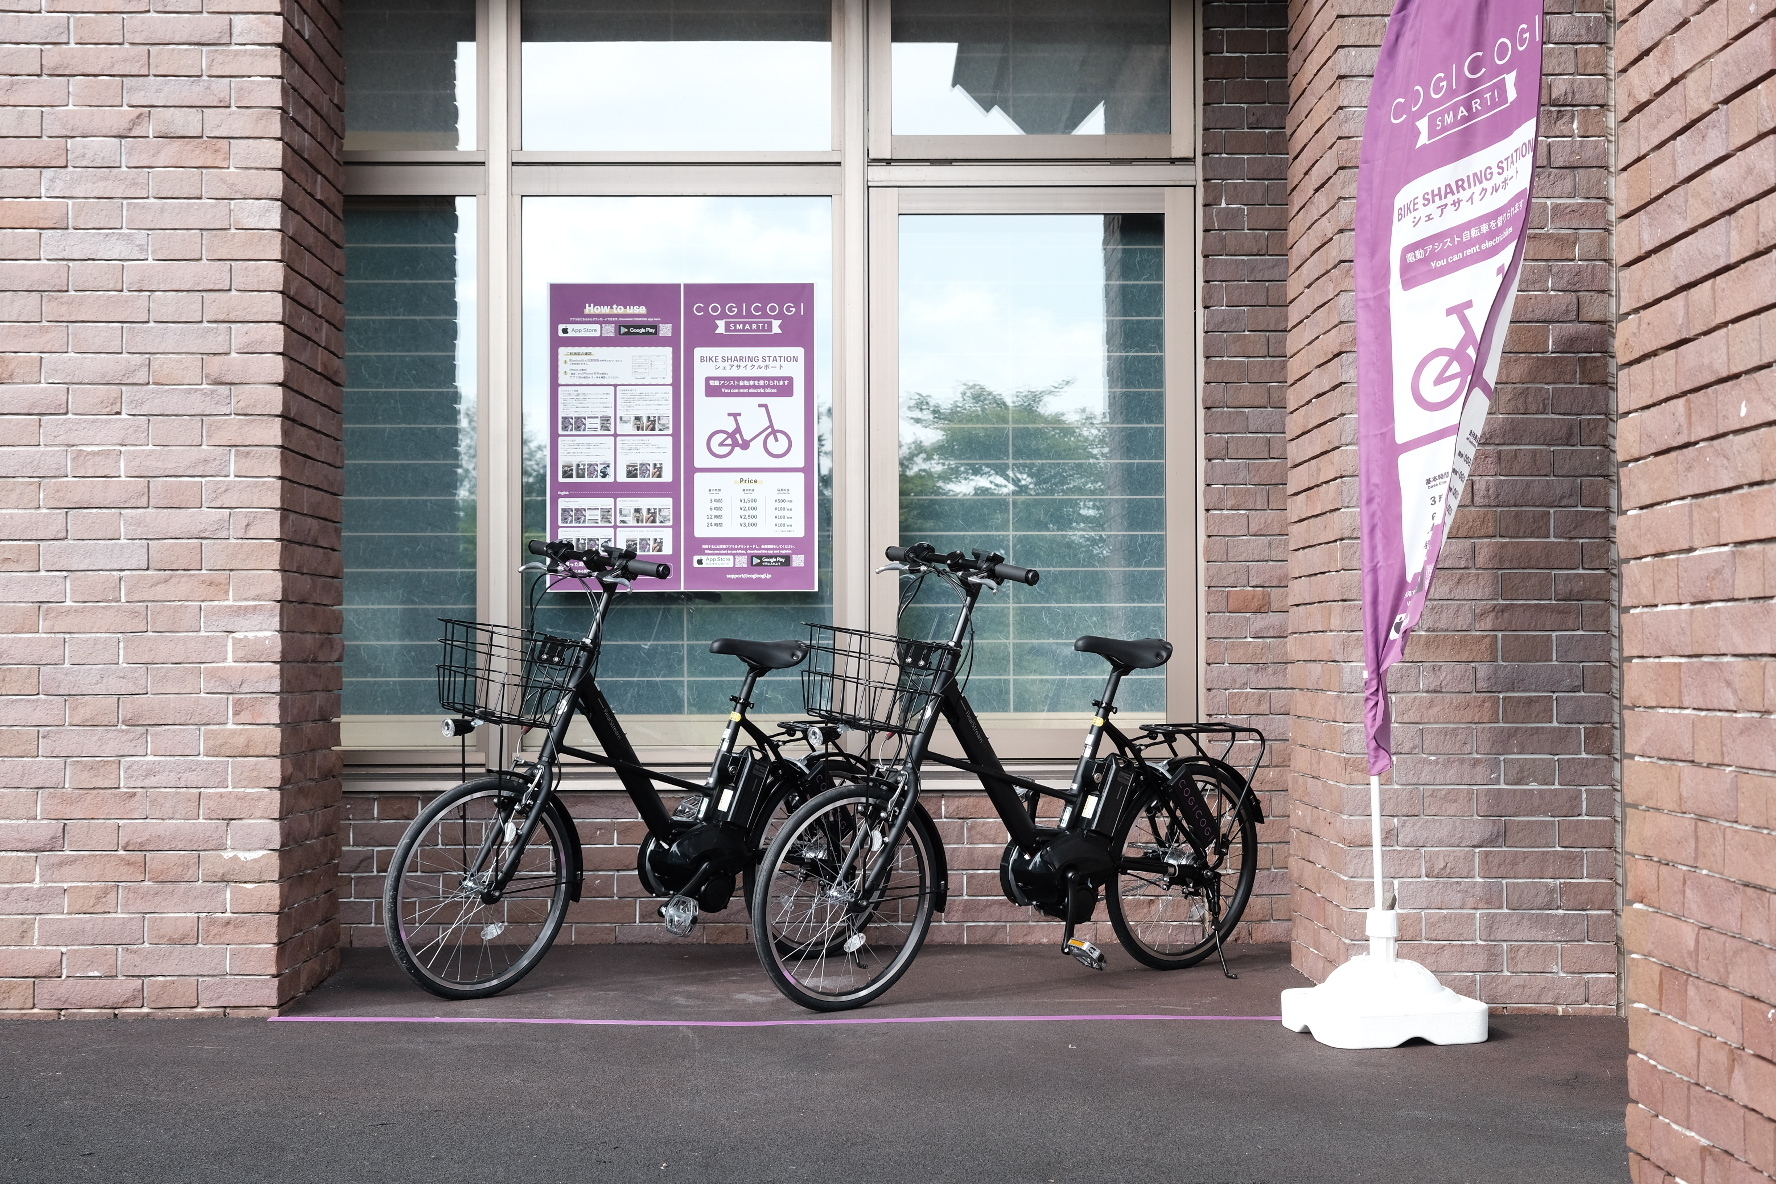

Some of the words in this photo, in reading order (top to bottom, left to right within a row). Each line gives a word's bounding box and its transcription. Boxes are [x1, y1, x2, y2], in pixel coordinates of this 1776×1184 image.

[1390, 14, 1539, 124] COGICOGI
[1436, 89, 1498, 130] SMART!
[1397, 196, 1419, 222] BIKE
[1422, 165, 1494, 207] SHARING
[1496, 137, 1534, 176] STATION
[1411, 166, 1519, 228] シェアサイクルポート
[1405, 199, 1525, 264] 電動アシスト自転車を借りられます
[1430, 258, 1447, 269] You
[1448, 252, 1463, 263] can
[1463, 244, 1480, 257] rent
[1481, 233, 1504, 250] electric
[585, 303, 610, 313] How
[612, 304, 624, 313] to
[626, 305, 646, 313] use
[693, 303, 804, 316] COGICOGI
[699, 355, 719, 363] BIKE
[721, 355, 760, 363] SHARING
[761, 355, 799, 363] STATION
[1178, 779, 1215, 842] COGICOGI
